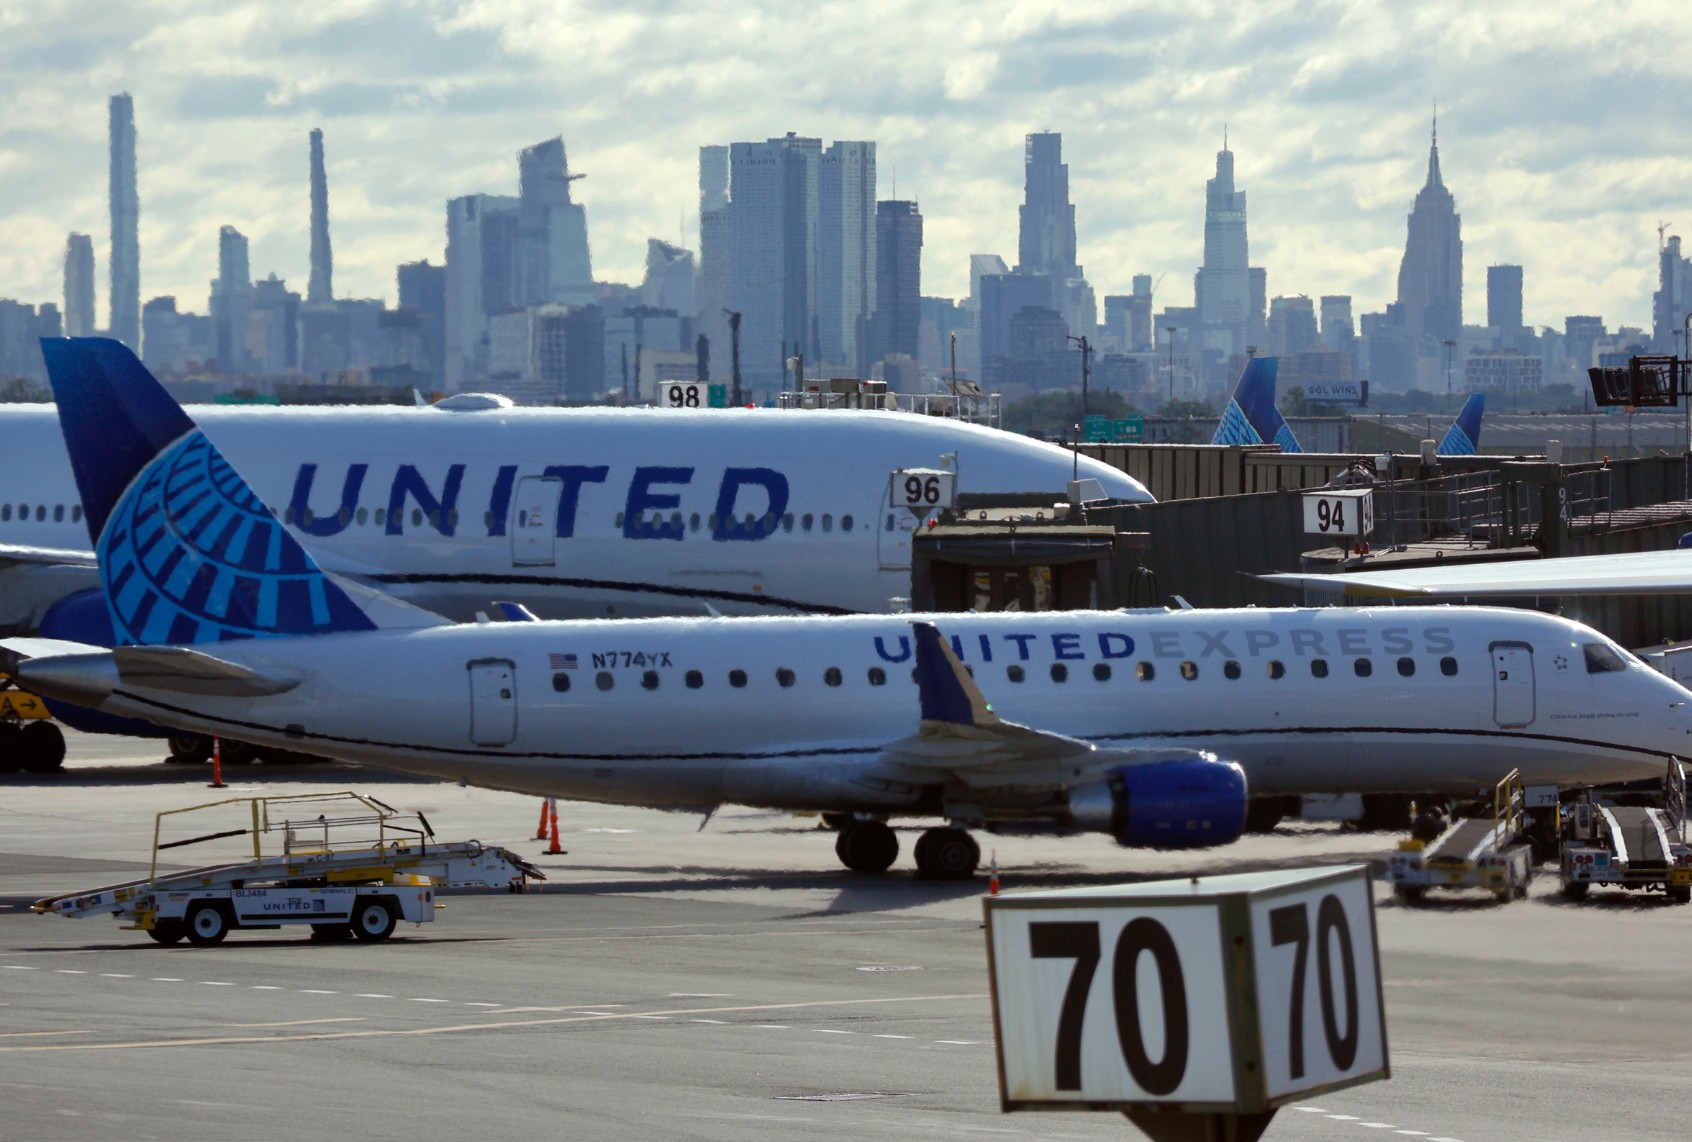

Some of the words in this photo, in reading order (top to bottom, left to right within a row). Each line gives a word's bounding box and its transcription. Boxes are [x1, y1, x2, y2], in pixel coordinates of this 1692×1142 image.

[669, 385, 699, 407] 98
[1331, 385, 1357, 394] WINS
[289, 463, 789, 541] UNITED
[905, 476, 939, 504] 96
[1318, 499, 1344, 532] 94
[1147, 627, 1455, 658] EXPRESS
[592, 651, 673, 669] N774YX
[263, 902, 311, 911] UNITED
[1268, 893, 1359, 1080] 70
[1028, 916, 1189, 1096] 70
